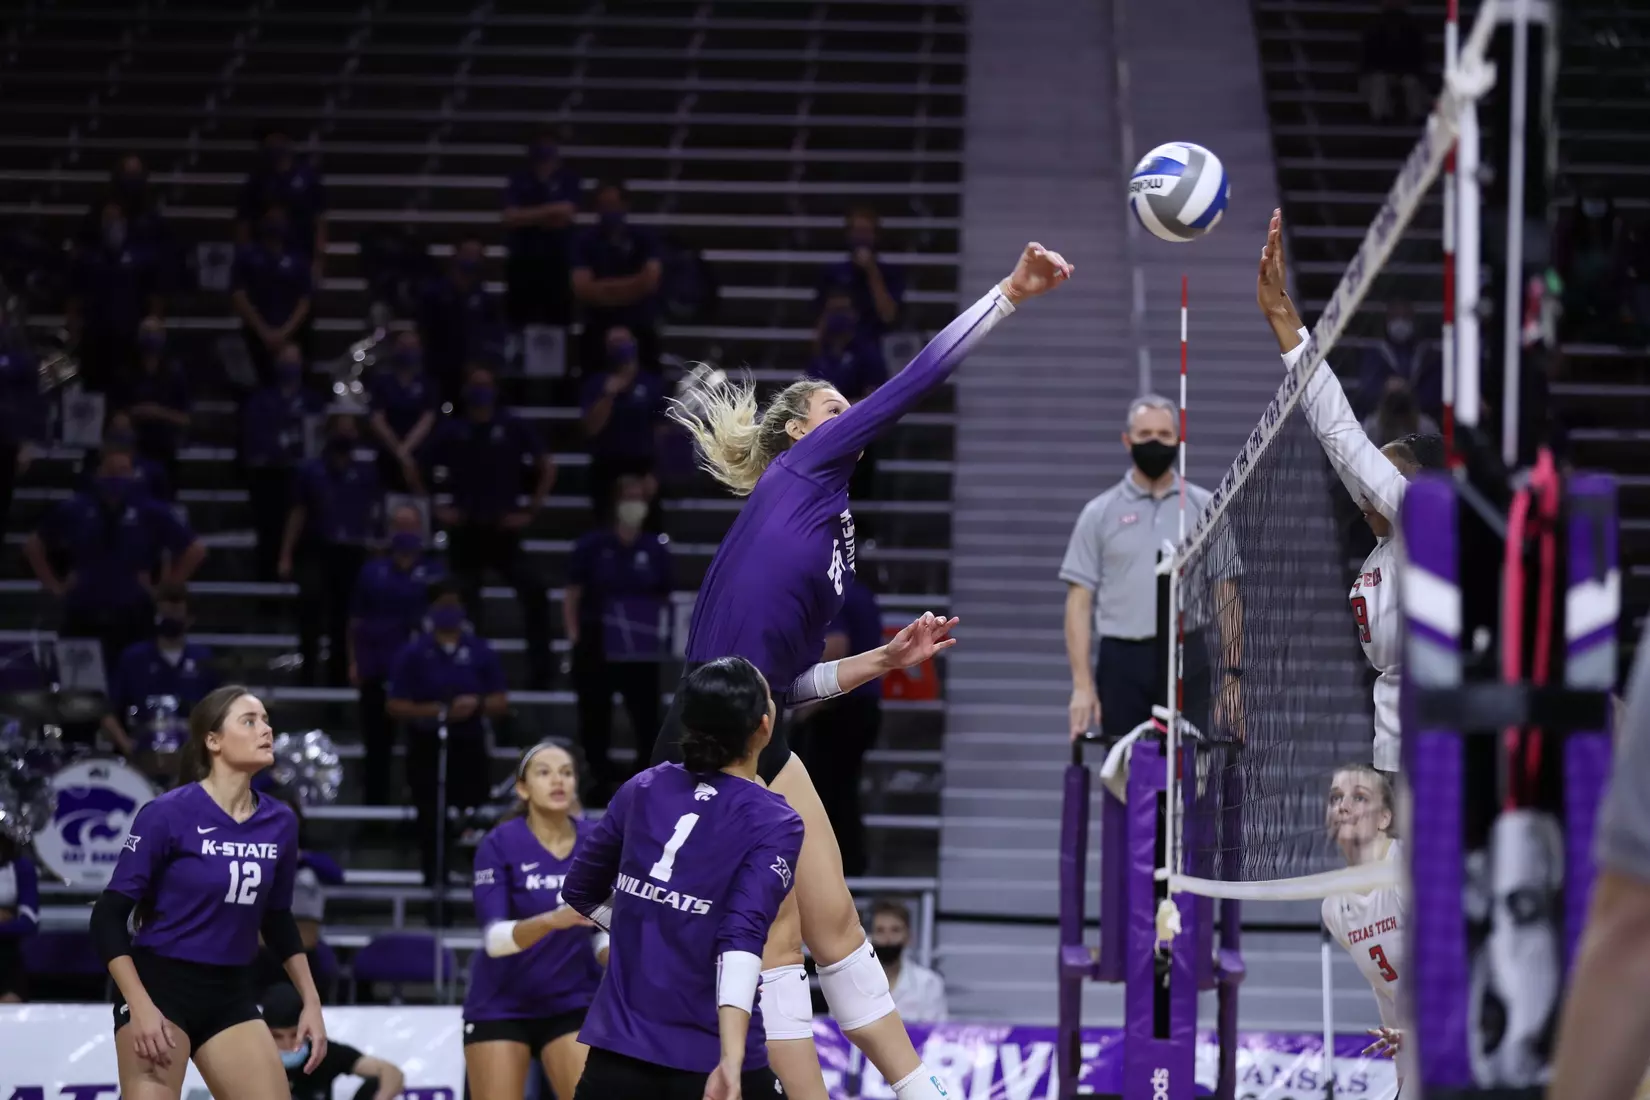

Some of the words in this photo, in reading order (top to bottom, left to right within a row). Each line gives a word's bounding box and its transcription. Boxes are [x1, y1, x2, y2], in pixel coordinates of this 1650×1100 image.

[1351, 596, 1372, 643] 9
[201, 839, 278, 859] K-STATE
[649, 812, 700, 882] 1
[224, 860, 262, 905] 12
[616, 872, 713, 915] WILDCATS
[1347, 925, 1374, 946] TEXAS
[1375, 916, 1397, 935] TECH
[1369, 944, 1399, 983] 3
